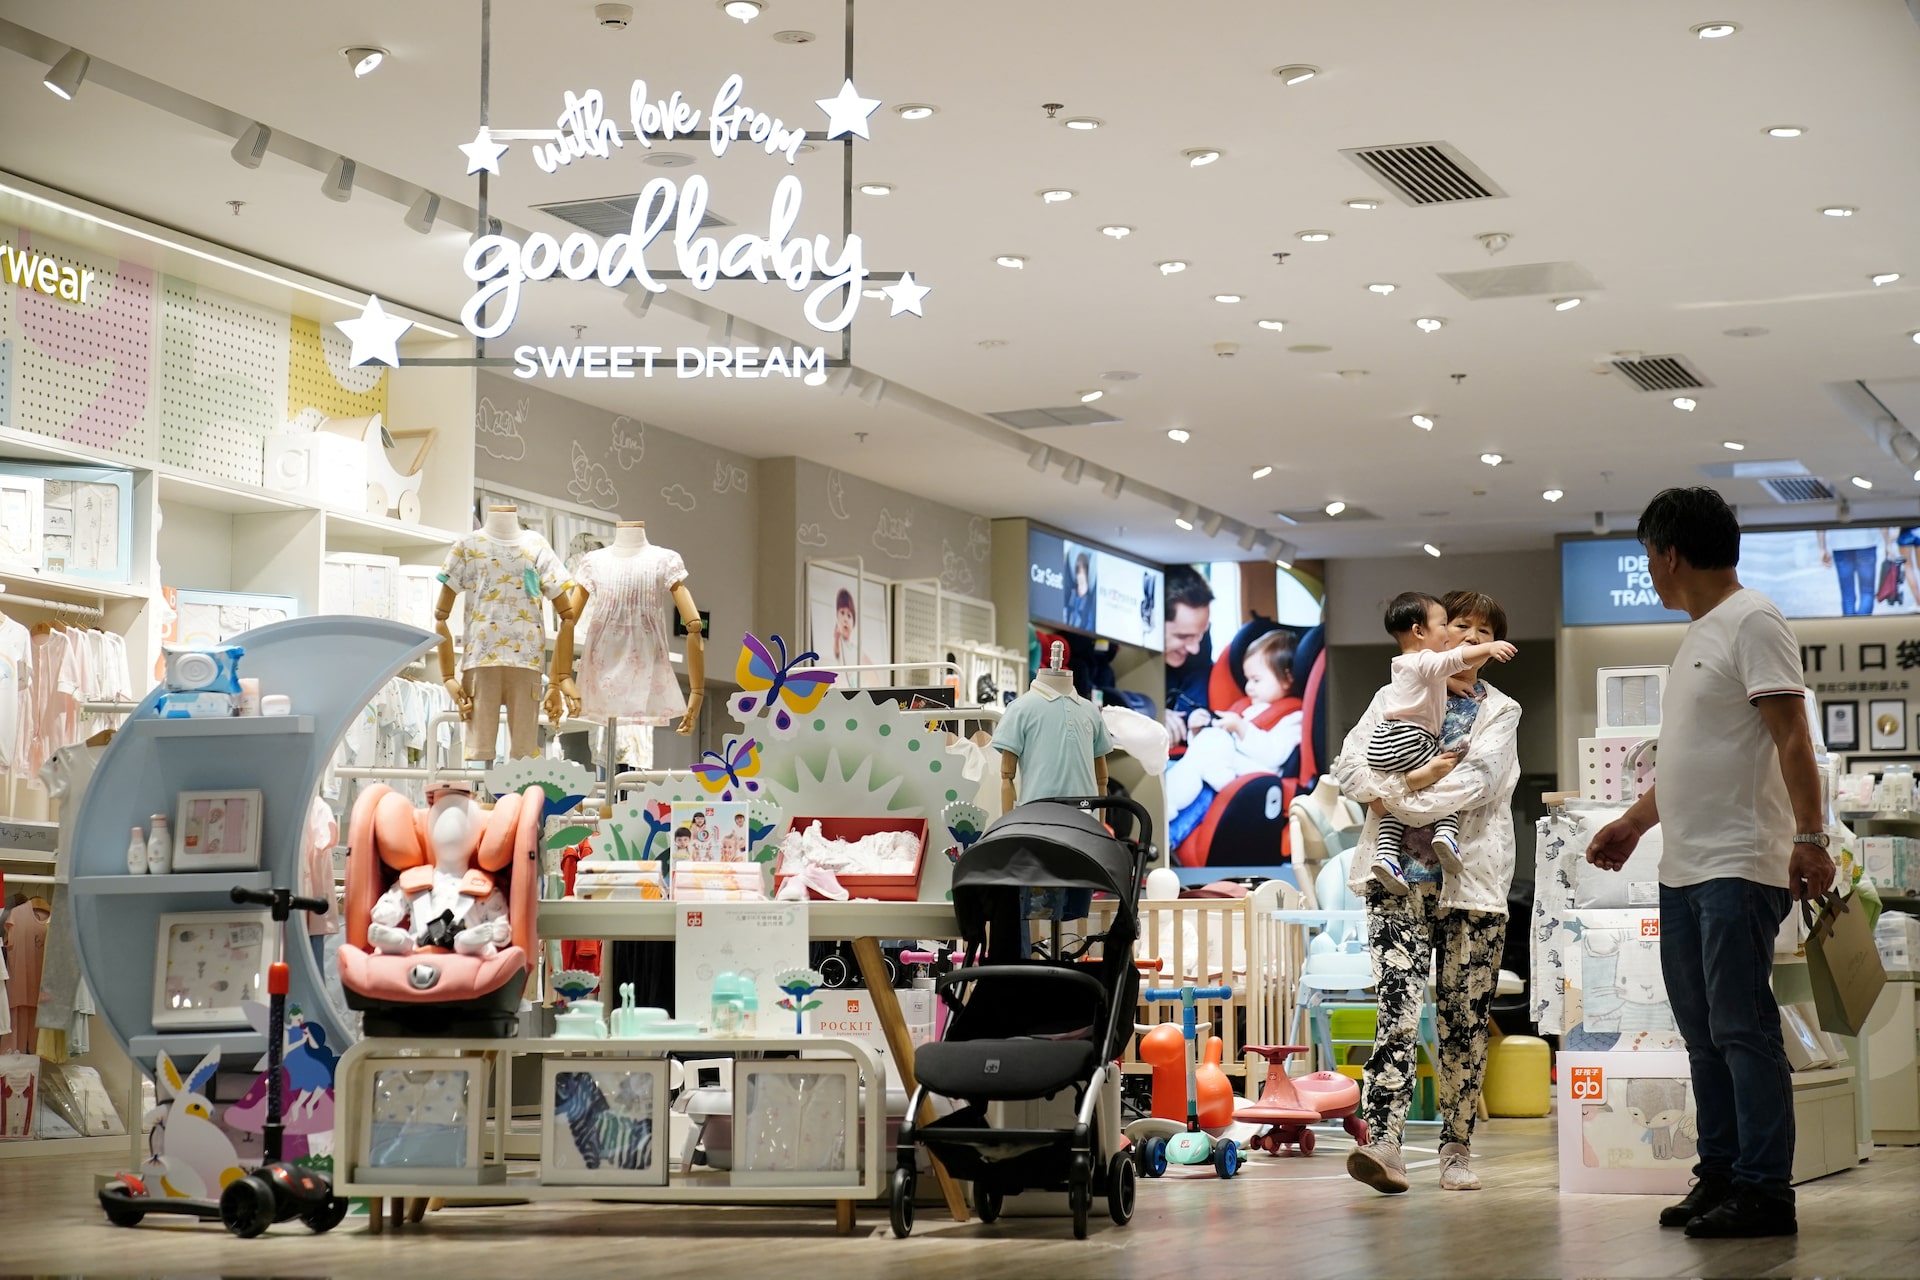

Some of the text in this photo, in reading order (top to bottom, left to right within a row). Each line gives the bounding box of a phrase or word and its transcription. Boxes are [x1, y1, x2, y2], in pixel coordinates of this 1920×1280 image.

[532, 73, 807, 175] with love from
[513, 345, 827, 379] SWEET DREAM
[688, 915, 701, 926] gb
[1643, 923, 1658, 936] gb
[820, 1021, 873, 1031] POCKIT
[1574, 1076, 1600, 1100] gb
